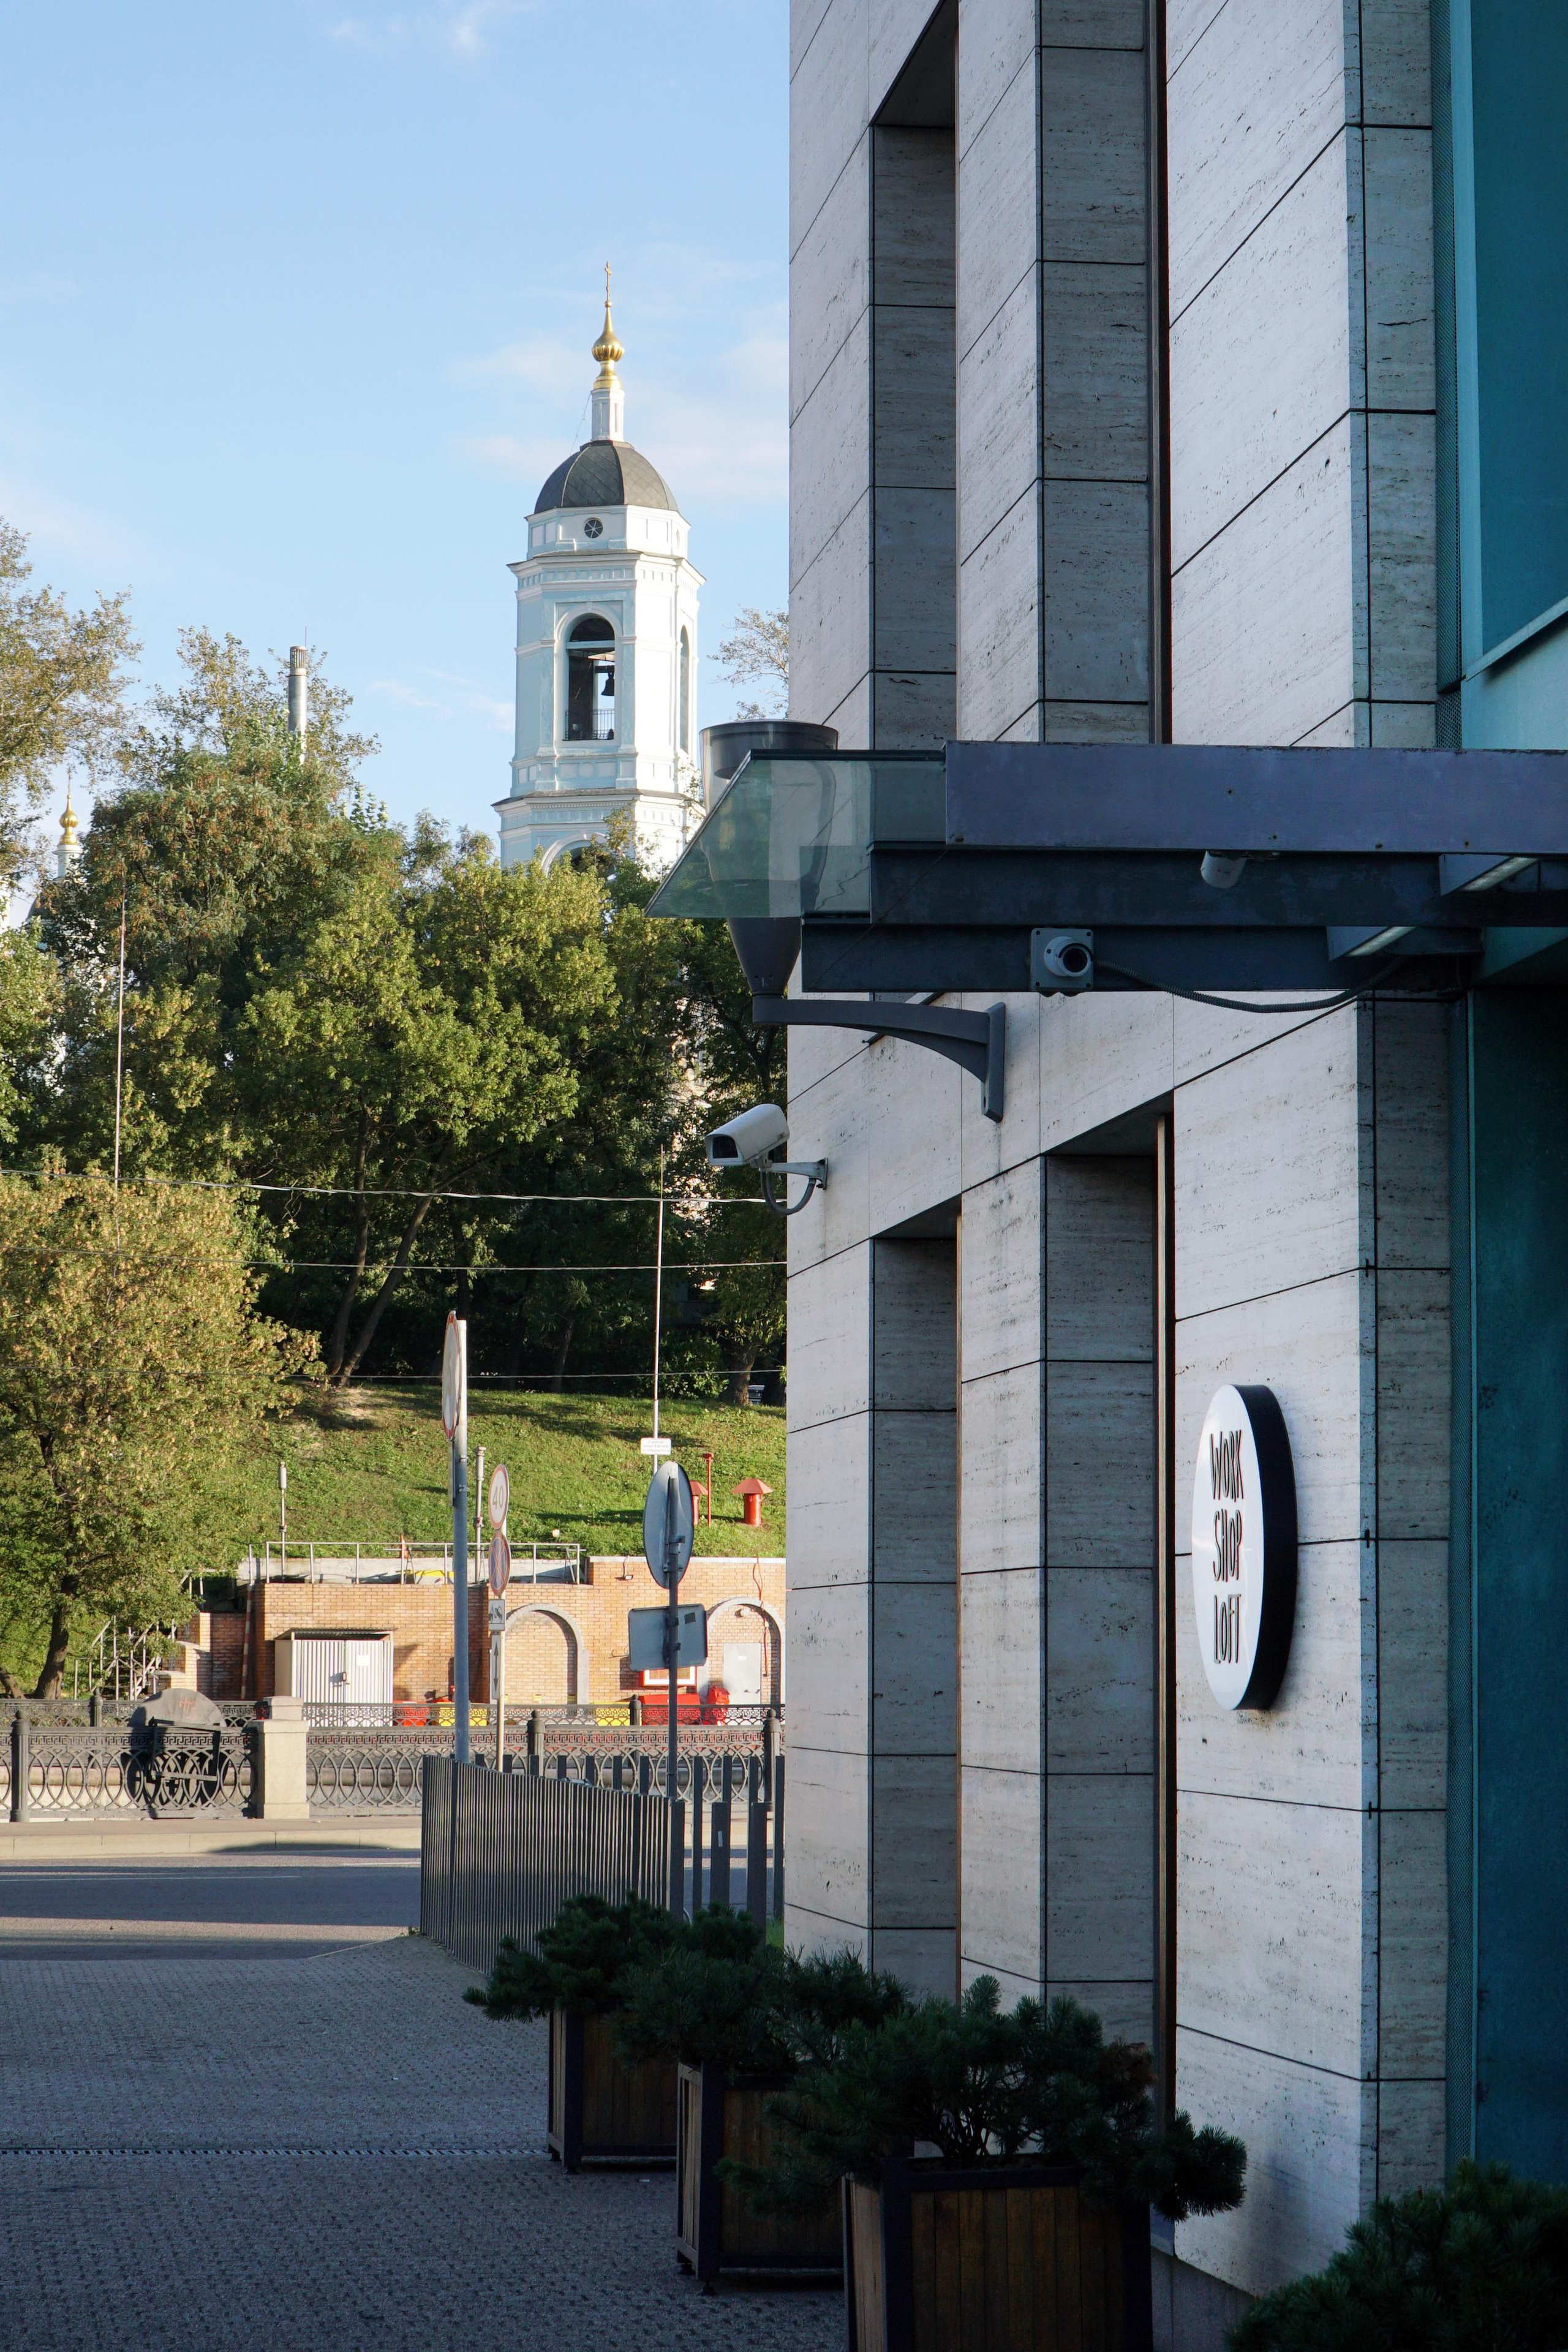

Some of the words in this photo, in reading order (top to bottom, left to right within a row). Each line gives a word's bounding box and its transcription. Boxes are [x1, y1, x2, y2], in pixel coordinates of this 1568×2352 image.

[492, 1485, 504, 1509] 40
[1210, 1430, 1244, 1502] WORK
[1213, 1509, 1242, 1581] SHOP
[1213, 1594, 1242, 1664] LOFT
